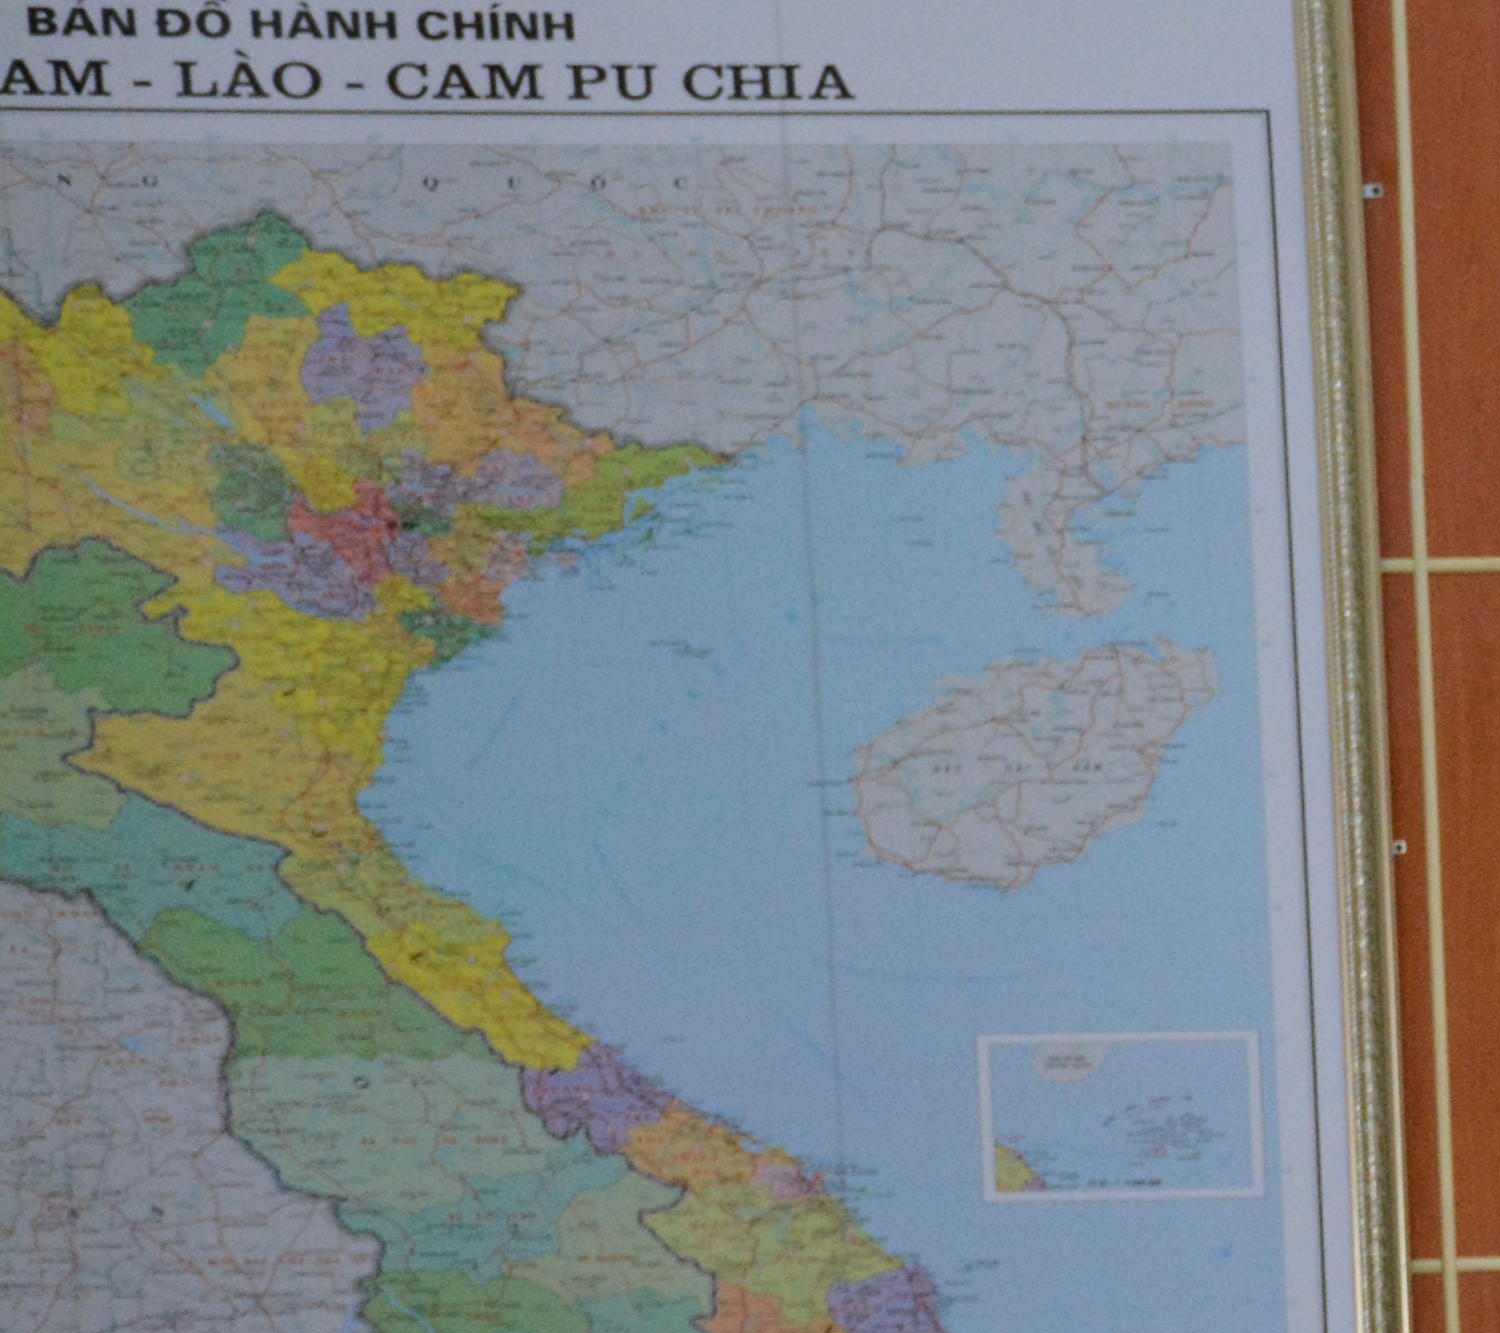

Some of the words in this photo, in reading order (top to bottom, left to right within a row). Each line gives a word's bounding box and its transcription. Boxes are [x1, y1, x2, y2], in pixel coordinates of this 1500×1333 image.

[416, 3, 575, 41] CHÍNH
[175, 50, 322, 99] LÀO
[387, 62, 543, 100] CAM
[566, 63, 657, 100] PU
[683, 63, 856, 100] CHIA
